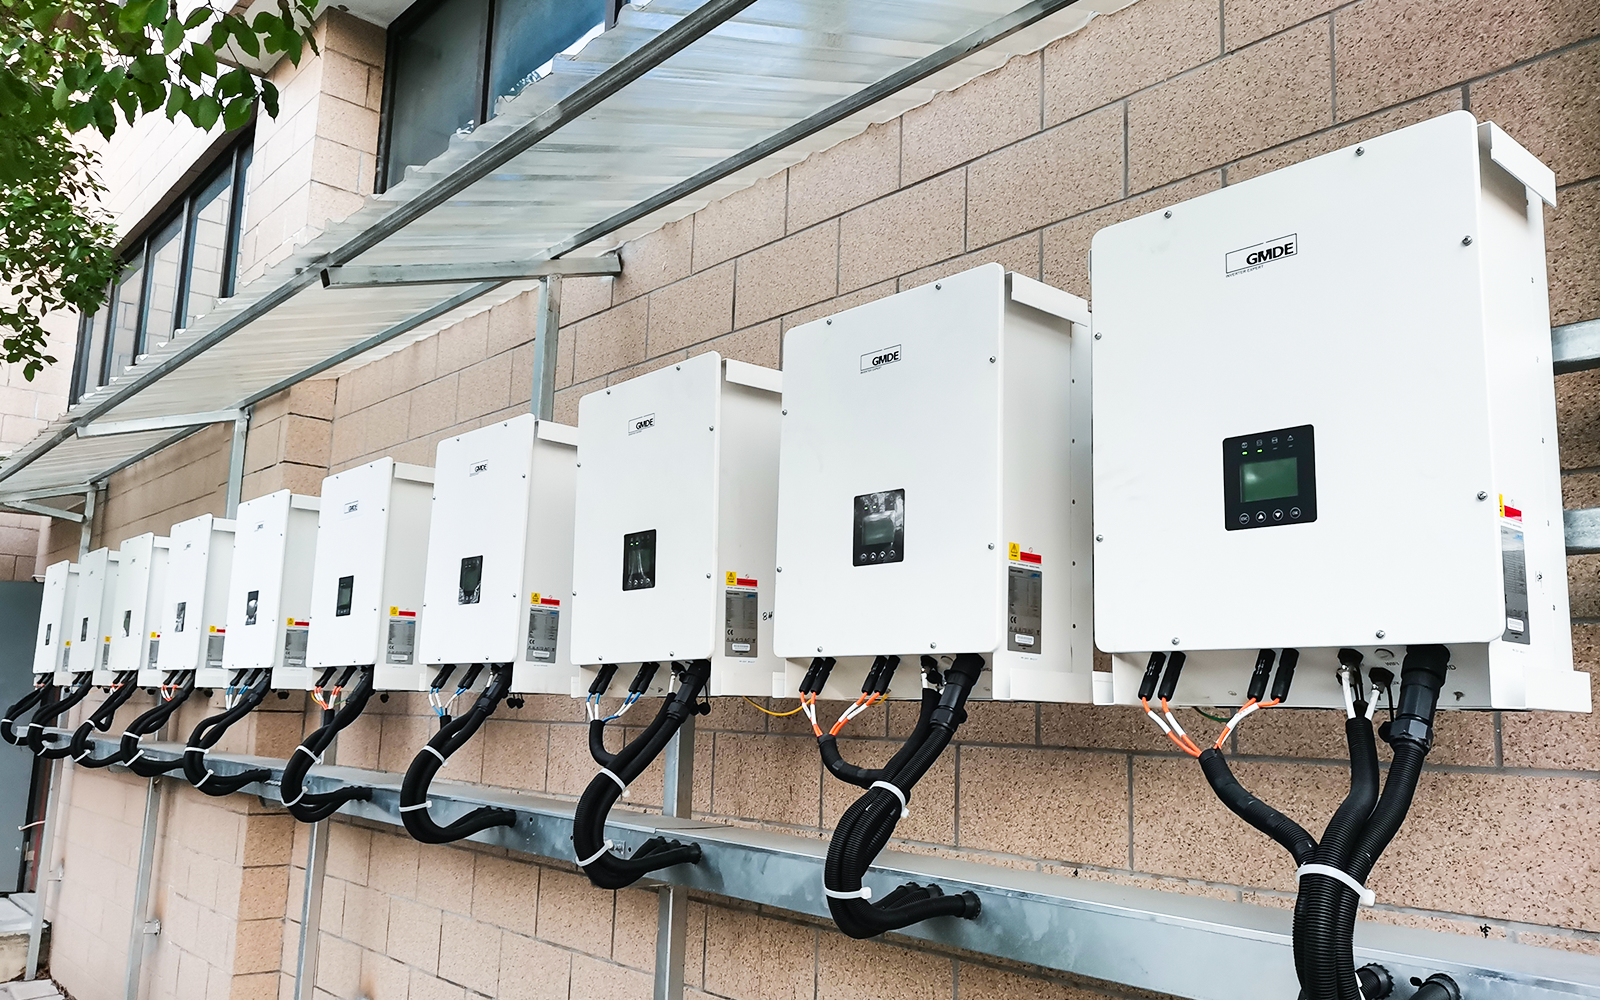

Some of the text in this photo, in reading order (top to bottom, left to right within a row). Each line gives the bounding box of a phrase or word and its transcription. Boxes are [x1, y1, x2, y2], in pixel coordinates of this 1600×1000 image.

[1246, 242, 1294, 265] GMDE
[872, 350, 899, 366] GMDE
[635, 417, 654, 430] GMDE
